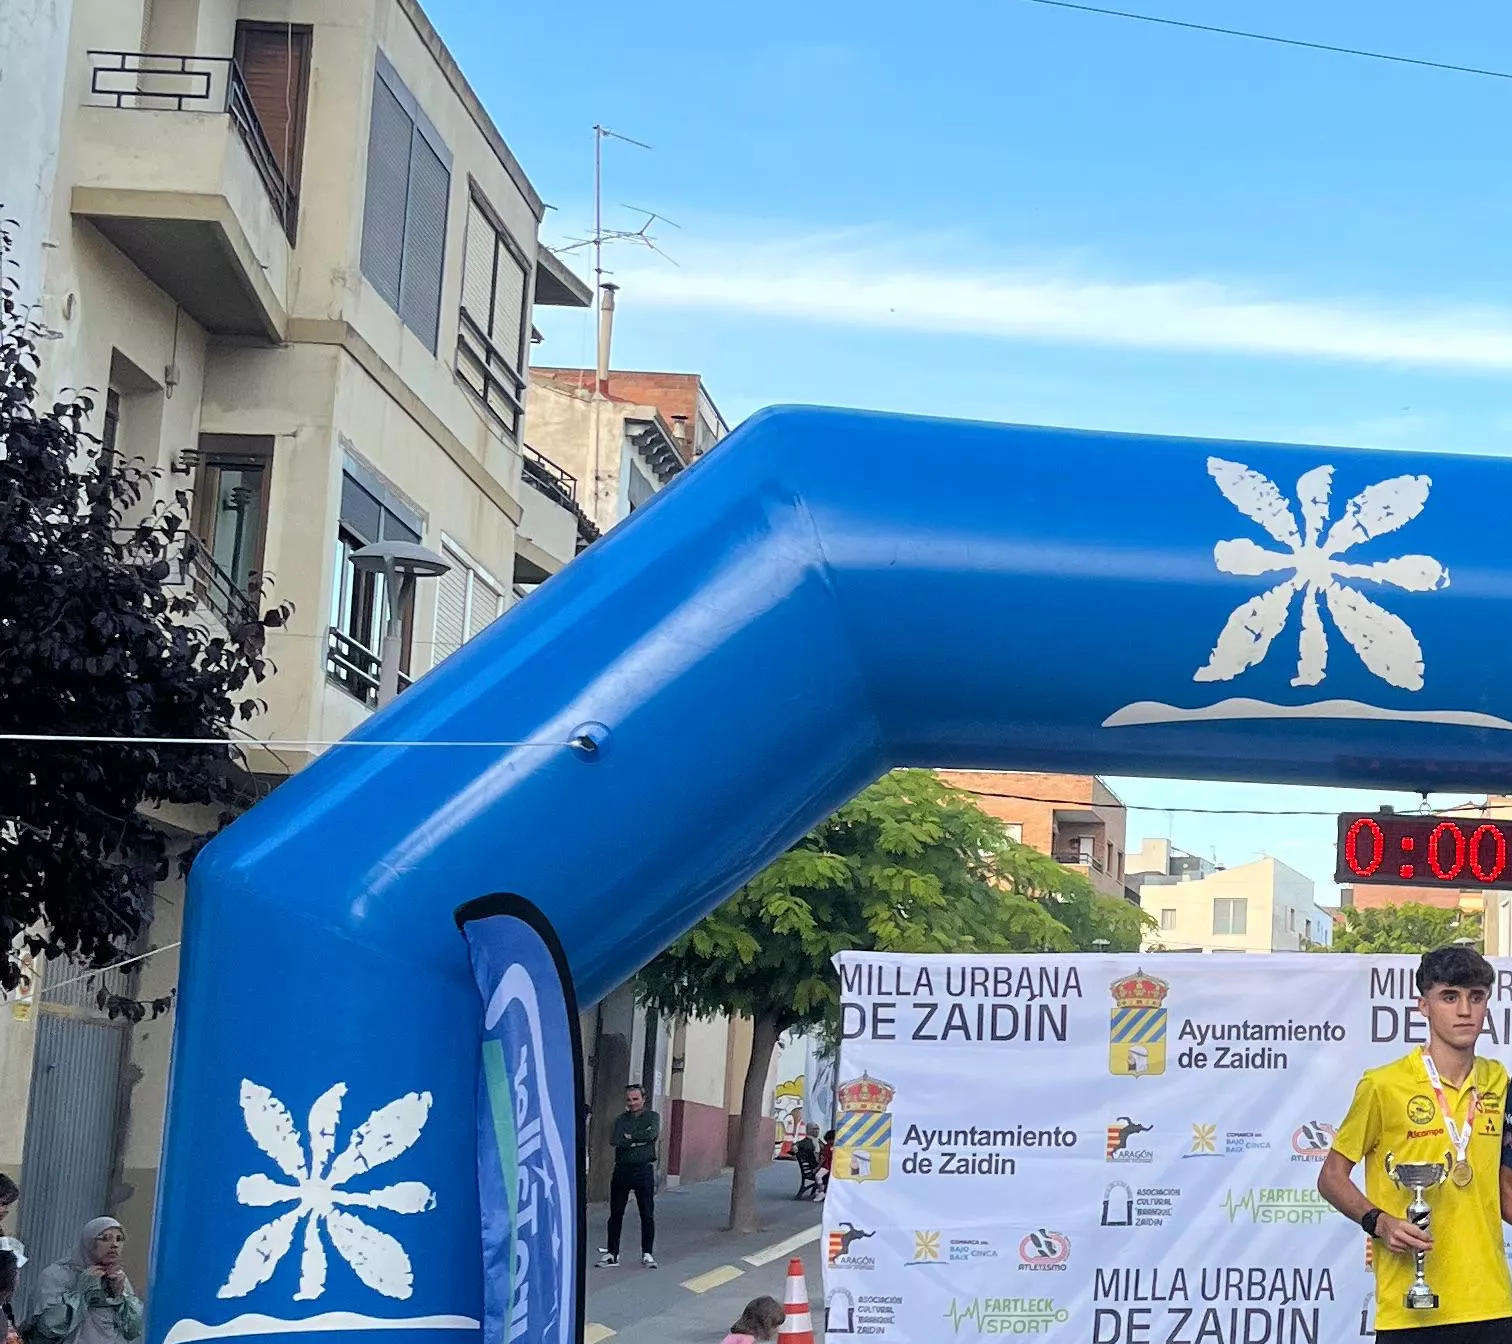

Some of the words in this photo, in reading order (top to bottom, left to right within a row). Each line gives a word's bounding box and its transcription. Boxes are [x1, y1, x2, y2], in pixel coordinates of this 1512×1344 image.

[840, 963, 934, 996] MILLA
[946, 966, 1083, 998] URBANA
[1370, 967, 1420, 1000] MIL
[841, 1002, 897, 1040] DE
[912, 994, 1068, 1042] ZAIDÍN
[1178, 1019, 1346, 1046] Ayuntamiento
[1178, 1047, 1208, 1069] de
[1213, 1047, 1288, 1069] Zaidin
[902, 1124, 1078, 1151] Ayuntamiento
[902, 1153, 933, 1175] de
[939, 1153, 1016, 1176] Zaidin
[1261, 1209, 1325, 1224] SPORT
[1018, 1263, 1067, 1271] ATLETISMO
[1093, 1268, 1189, 1302] MILLA
[1201, 1268, 1335, 1301] URBANA
[984, 1298, 1055, 1312] FARTLECK
[987, 1320, 1051, 1333] SPORT
